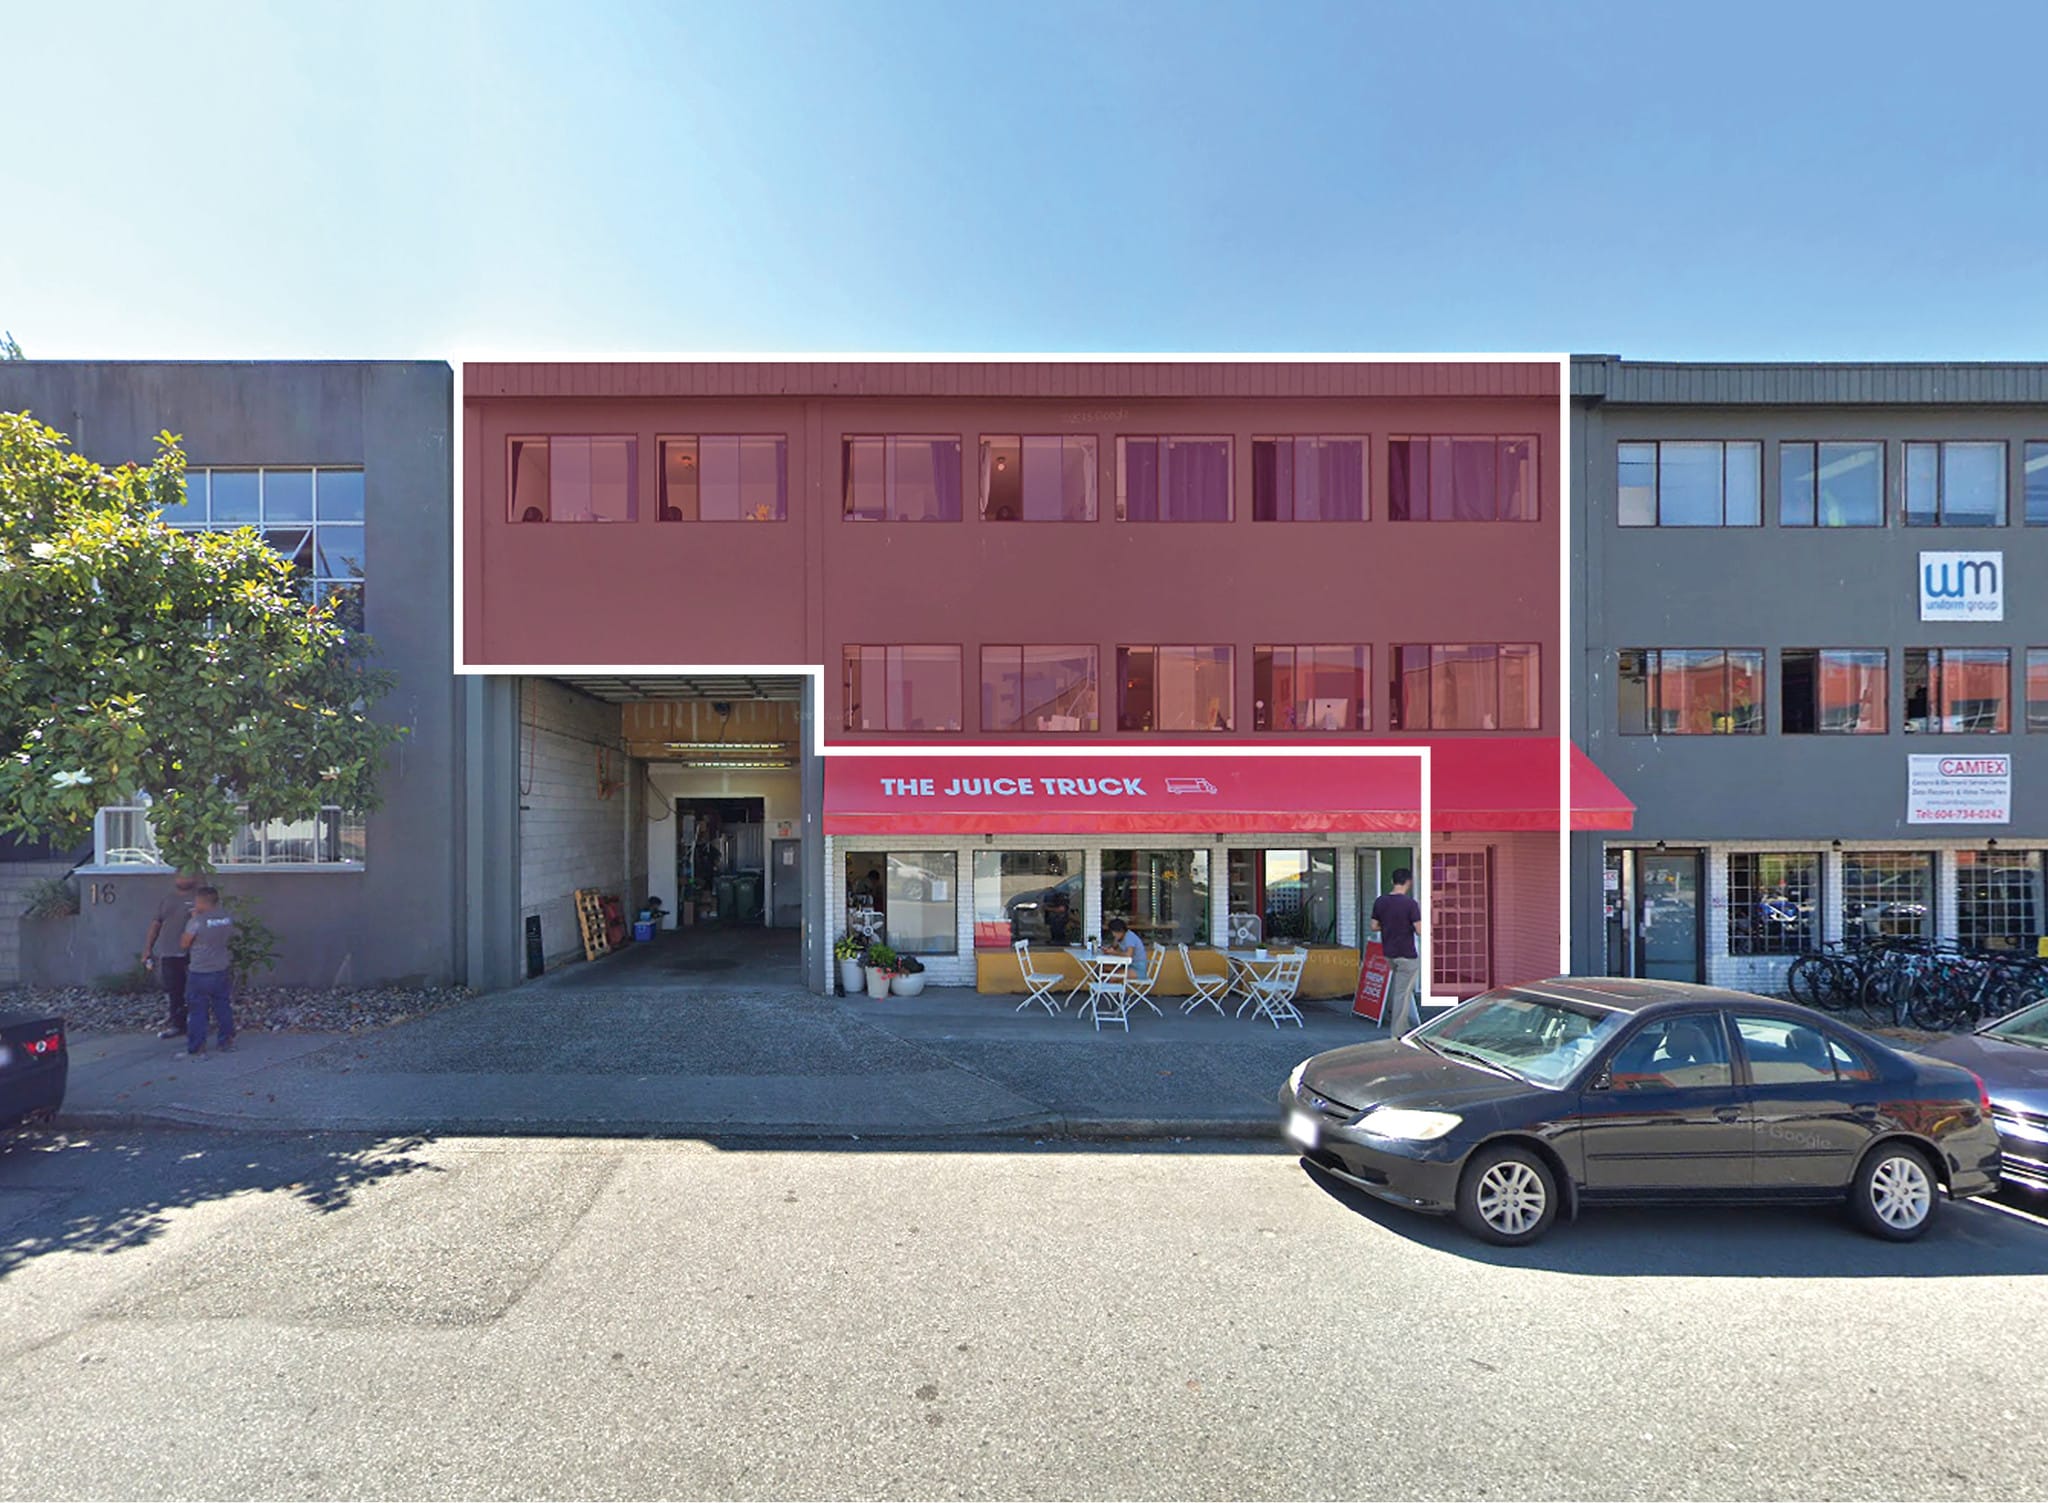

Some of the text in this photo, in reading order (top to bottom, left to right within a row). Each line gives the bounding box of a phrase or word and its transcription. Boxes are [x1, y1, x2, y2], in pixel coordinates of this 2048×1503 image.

[1967, 601, 1998, 612] group
[1942, 760, 2005, 774] CAMTEX
[880, 778, 1147, 796] THE JUICE TRUCK
[90, 883, 116, 905] 16
